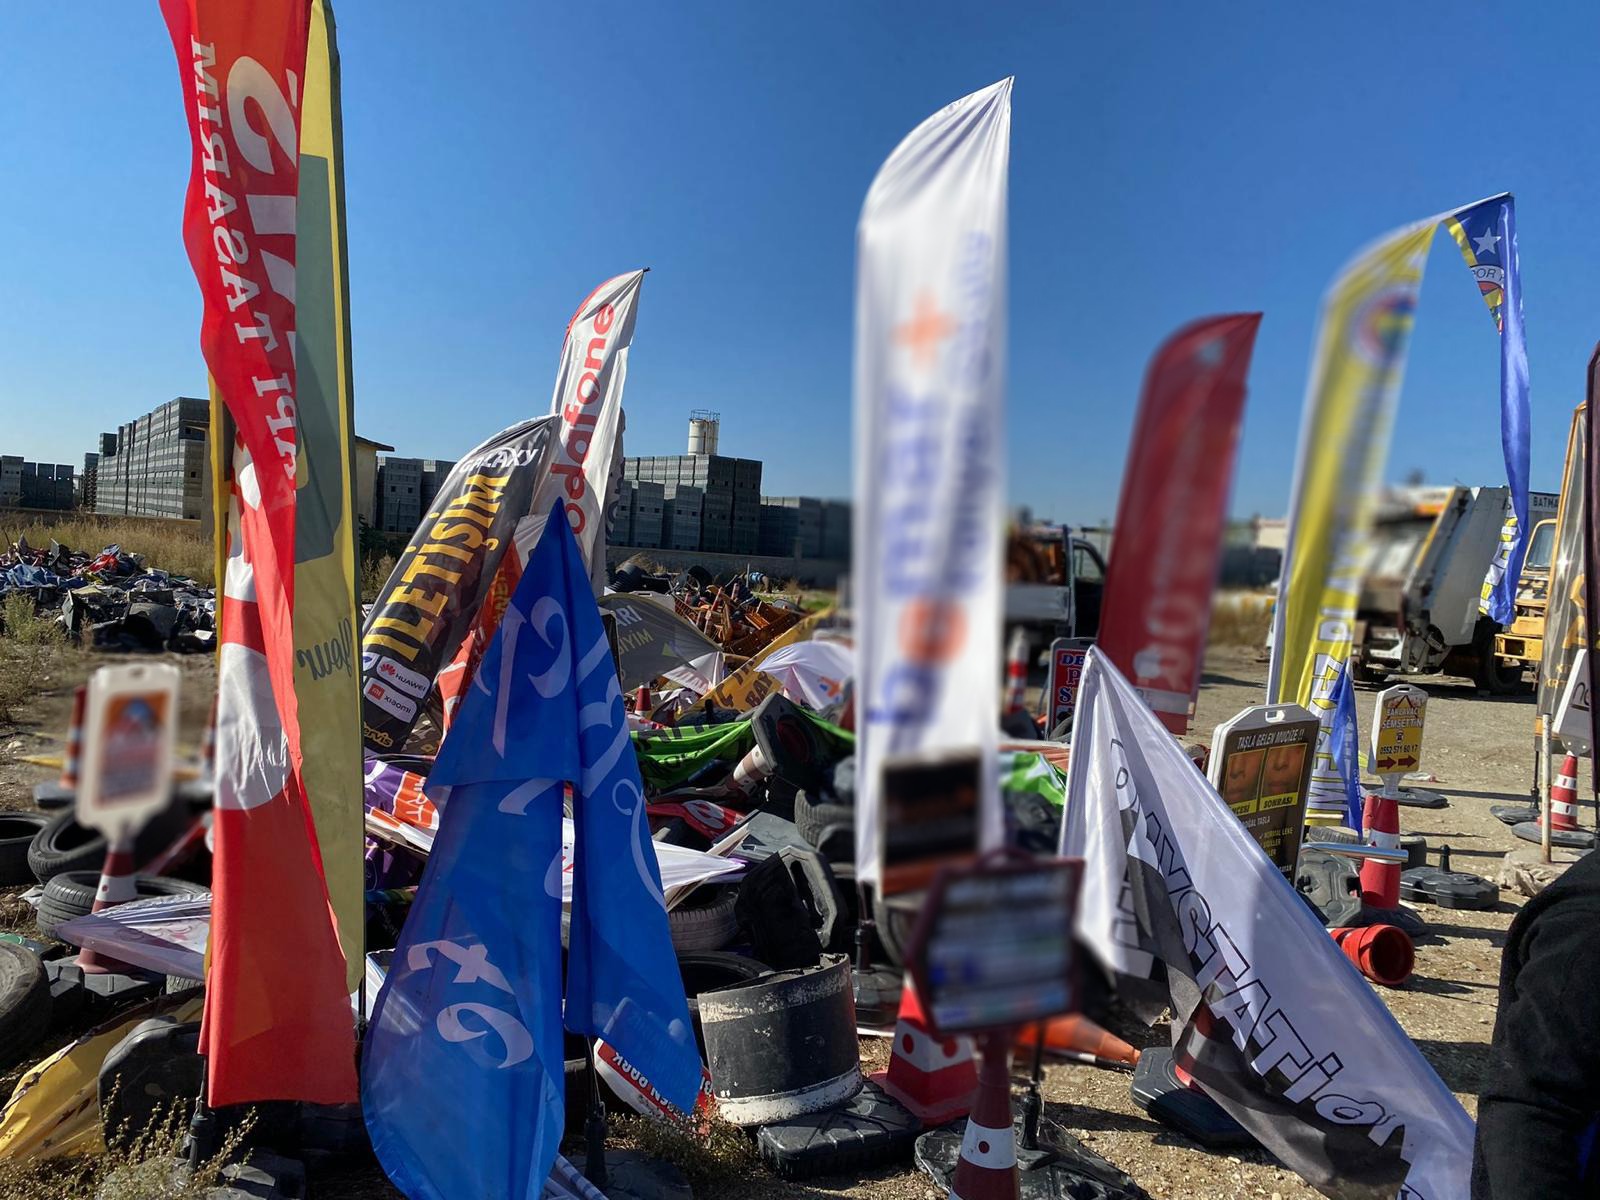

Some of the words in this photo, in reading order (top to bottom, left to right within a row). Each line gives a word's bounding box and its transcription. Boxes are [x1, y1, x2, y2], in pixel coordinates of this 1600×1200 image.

[551, 304, 615, 534] odafone
[395, 672, 426, 691] HUAWEI
[363, 724, 394, 748] ervis
[1230, 802, 1251, 815] NCESİ
